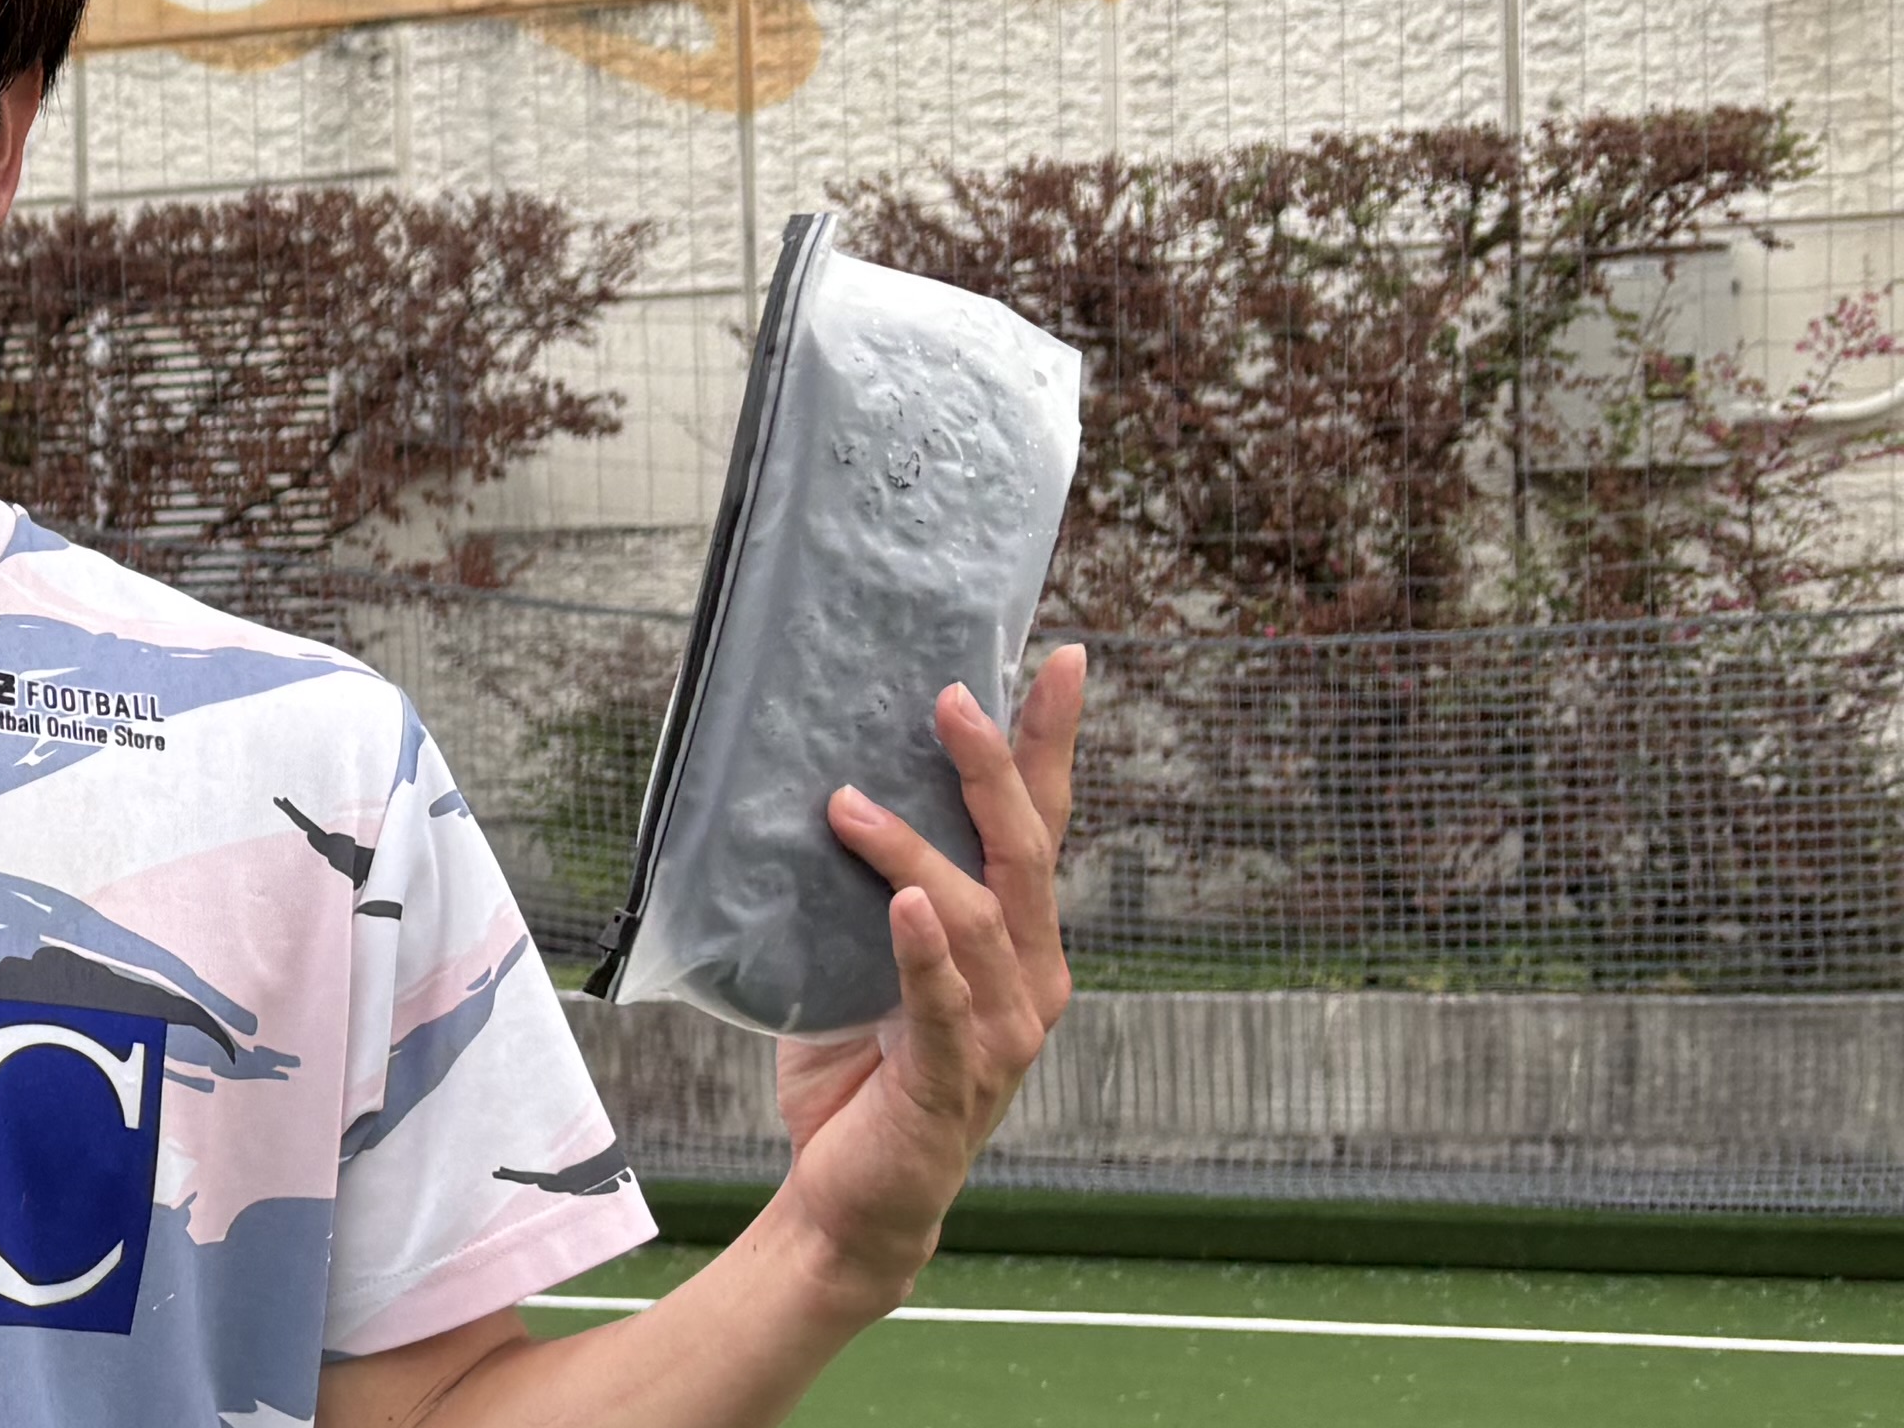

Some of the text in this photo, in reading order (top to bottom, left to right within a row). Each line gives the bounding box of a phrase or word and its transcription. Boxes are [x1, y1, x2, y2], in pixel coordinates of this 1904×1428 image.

[26, 680, 165, 723] FOOTBALL
[47, 716, 108, 744] Online
[114, 724, 166, 752] Store
